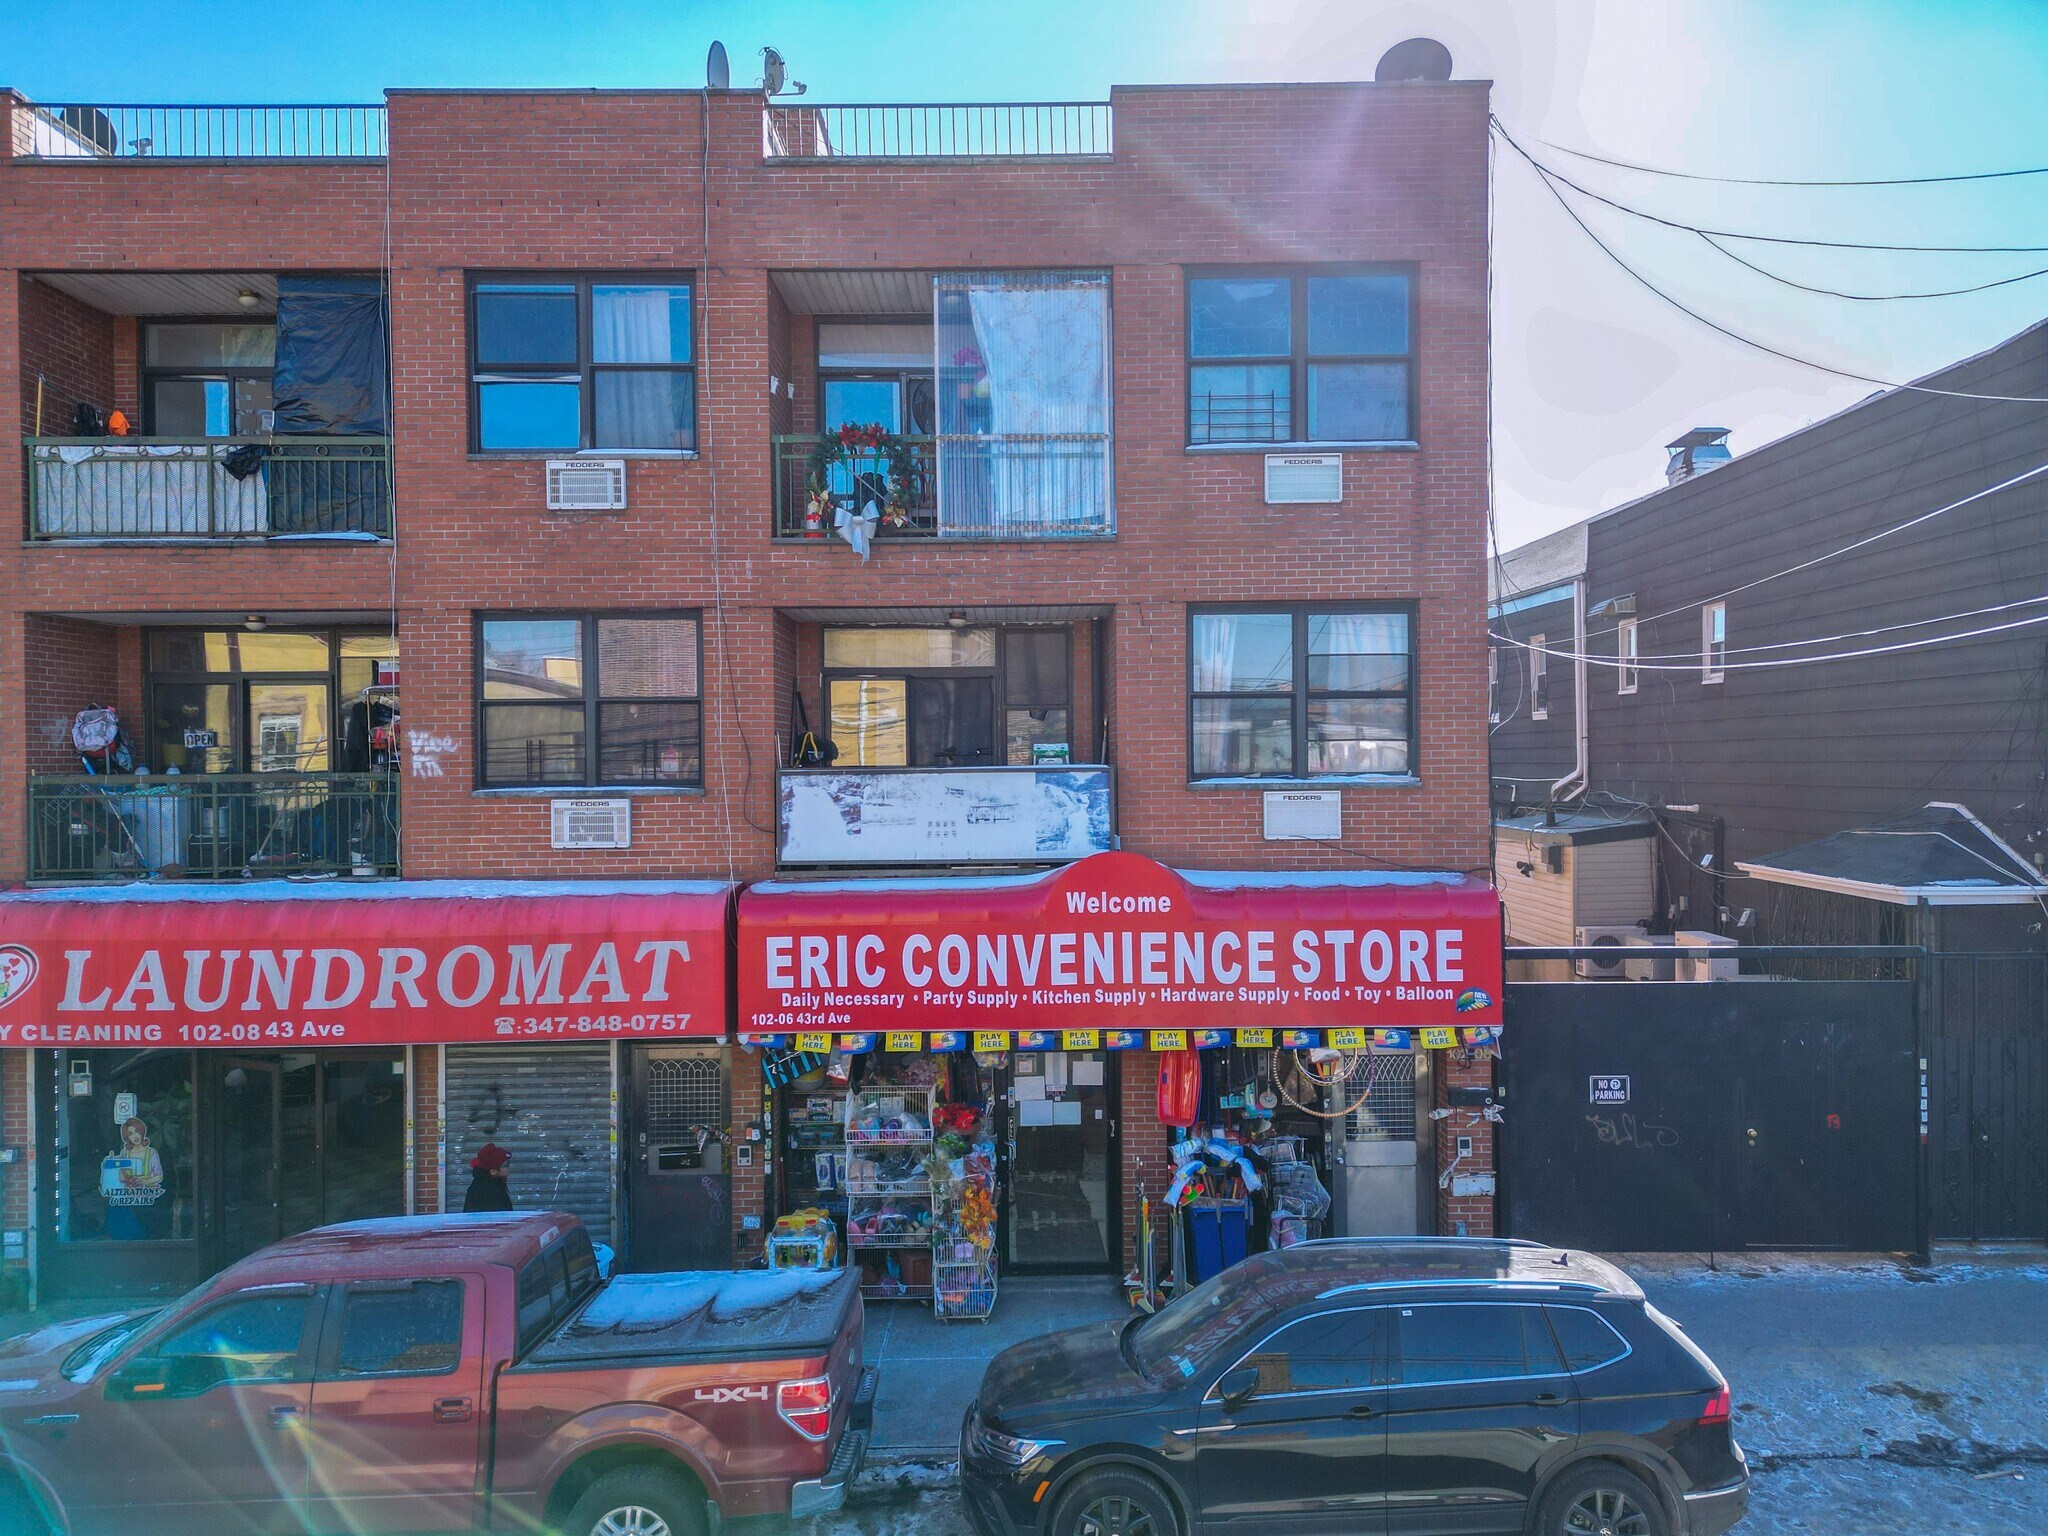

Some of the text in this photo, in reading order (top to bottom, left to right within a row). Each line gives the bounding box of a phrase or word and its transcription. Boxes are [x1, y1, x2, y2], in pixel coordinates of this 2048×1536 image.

[185, 733, 213, 747] OPEN
[1066, 892, 1171, 913] Welcome
[766, 930, 1464, 989] ERIC CONVENIENCE STORE
[57, 941, 691, 1013] LAUNDROMAT
[781, 985, 1454, 1010] Daily Necessary Party Supply Kitchen Supply Hardware Supply Food Toy Balloon
[751, 1012, 851, 1026] 102-06 43rd Ave
[21, 1024, 162, 1041] CLEANING
[178, 1024, 261, 1041] 102-08
[265, 1021, 294, 1038] 43
[301, 1021, 345, 1037] Ave
[1069, 1032, 1090, 1040] PLAY
[1157, 1032, 1179, 1040] PLAY
[1243, 1029, 1265, 1037] PLAY
[1426, 1030, 1448, 1038] PLAY
[804, 1034, 825, 1042] PLAY
[1598, 1079, 1608, 1089] NO
[1594, 1090, 1626, 1100] PARKING
[104, 1187, 160, 1197] ALTERATIONS
[109, 1196, 155, 1206] & REPAIRS
